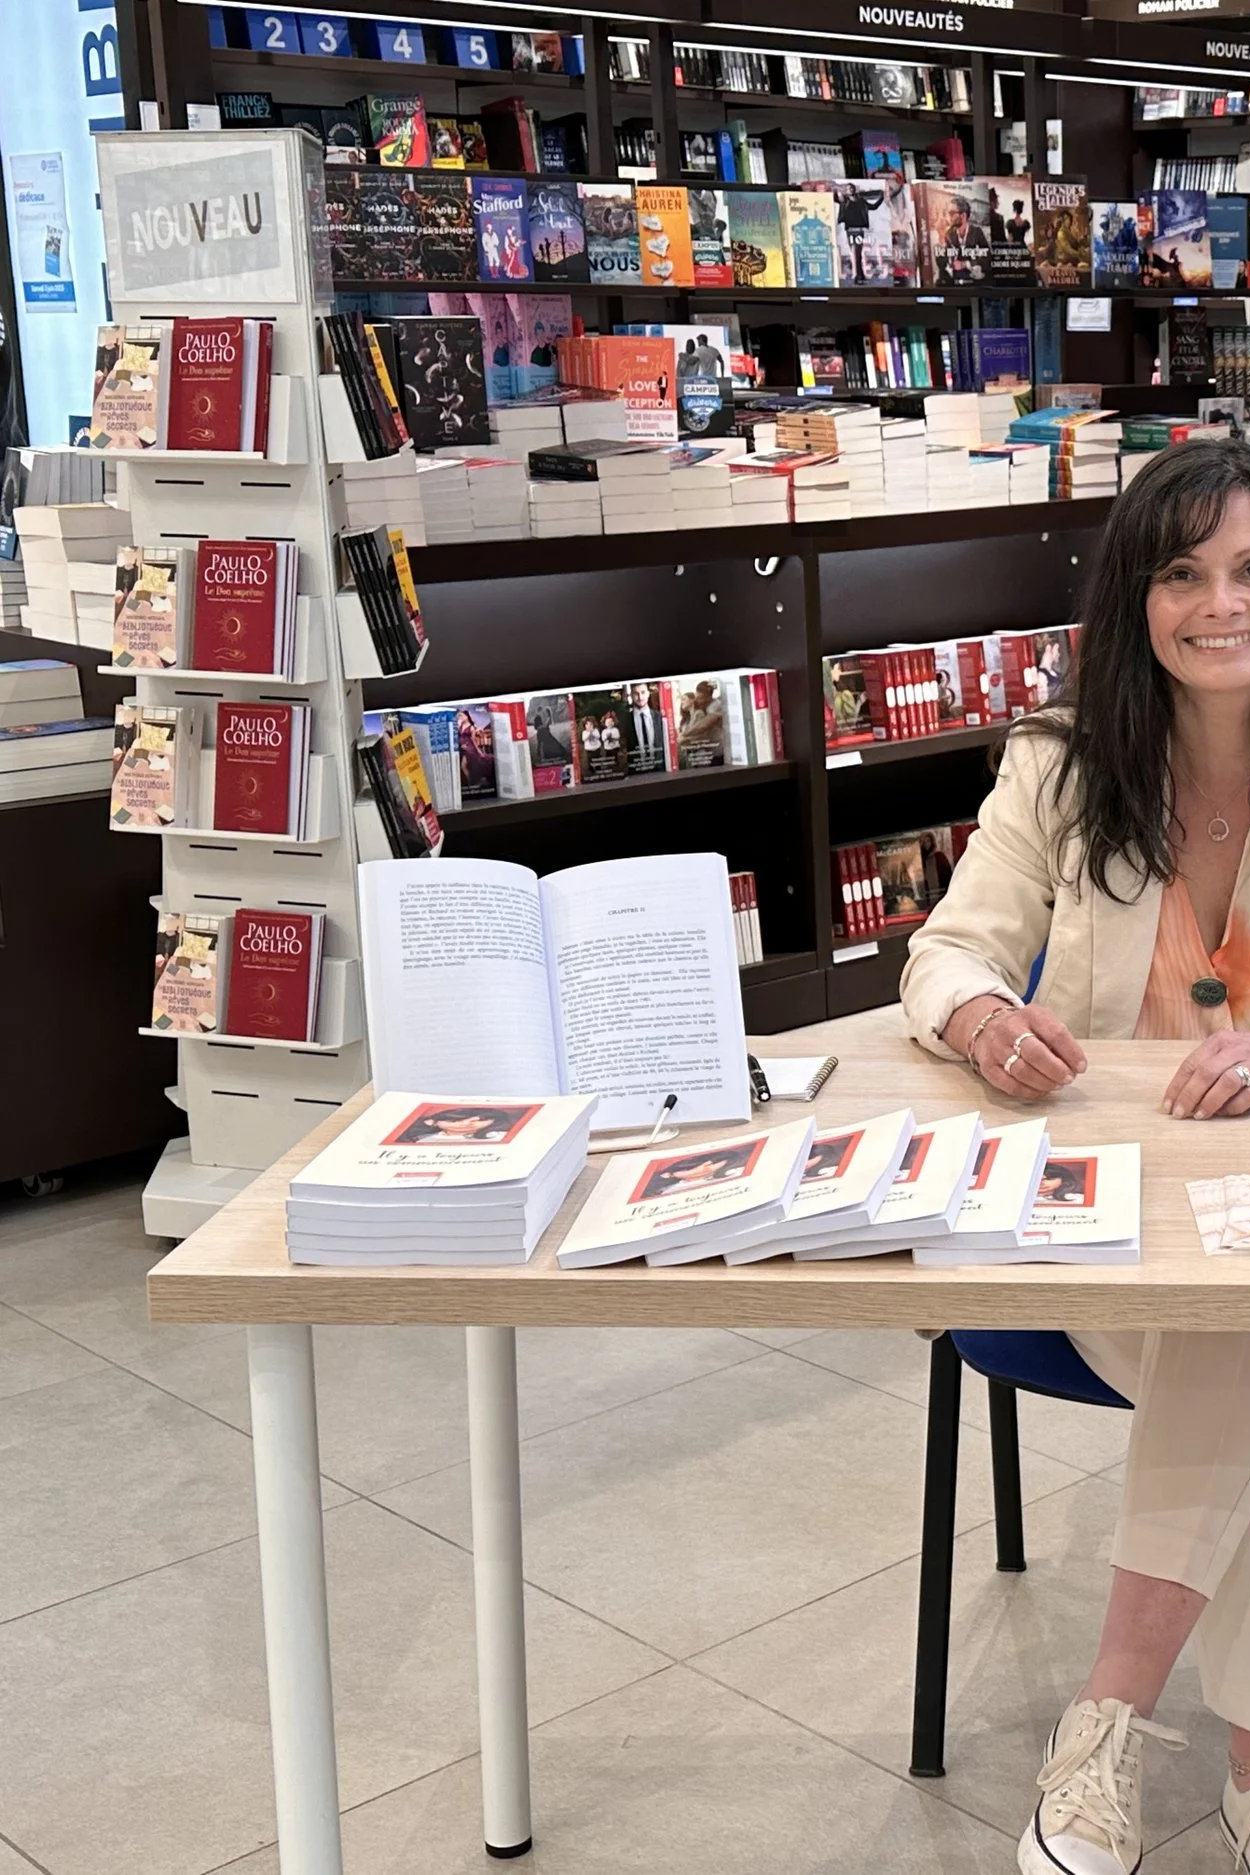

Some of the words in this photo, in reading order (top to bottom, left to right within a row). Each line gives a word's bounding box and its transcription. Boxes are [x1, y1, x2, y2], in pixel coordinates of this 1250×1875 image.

[859, 7, 964, 32] NOUVEAUTÉS
[264, 17, 286, 48] 2
[317, 22, 337, 52] 3
[393, 29, 412, 59] 4
[470, 36, 488, 65] 5
[222, 105, 272, 119] THILLIEZ
[473, 195, 523, 215] Stafford
[129, 190, 263, 253] NOUVEAU
[588, 257, 640, 272] NOUS
[185, 332, 231, 350] PAULO
[178, 346, 236, 363] COELHO
[628, 381, 659, 392] LOVE
[685, 386, 718, 394] CAMPUS
[210, 554, 261, 571] PAULO
[204, 567, 268, 585] COELHO
[230, 715, 277, 733] PAULO
[223, 729, 282, 747] COELHO
[248, 922, 297, 940] PAULO
[240, 935, 302, 955] COELHO
